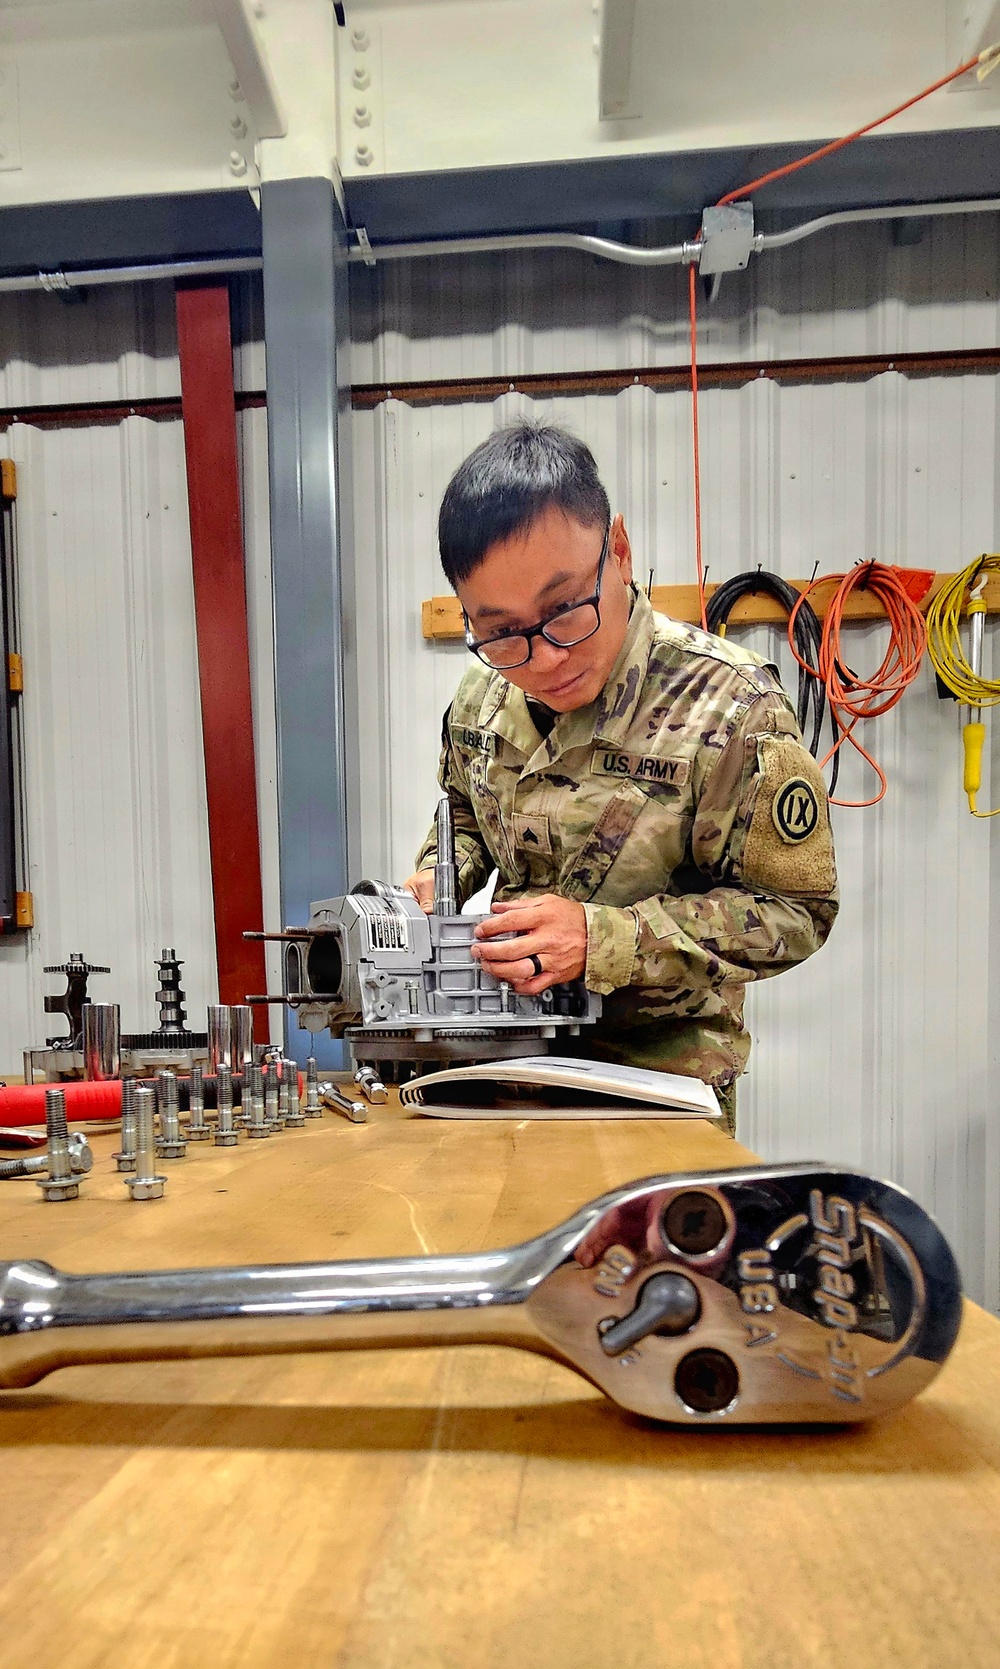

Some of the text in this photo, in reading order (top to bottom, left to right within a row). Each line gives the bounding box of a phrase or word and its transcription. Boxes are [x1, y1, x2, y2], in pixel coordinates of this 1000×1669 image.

[603, 754, 678, 780] U.S. ARMY
[786, 794, 810, 828] IX
[810, 1188, 862, 1404] Snap-on
